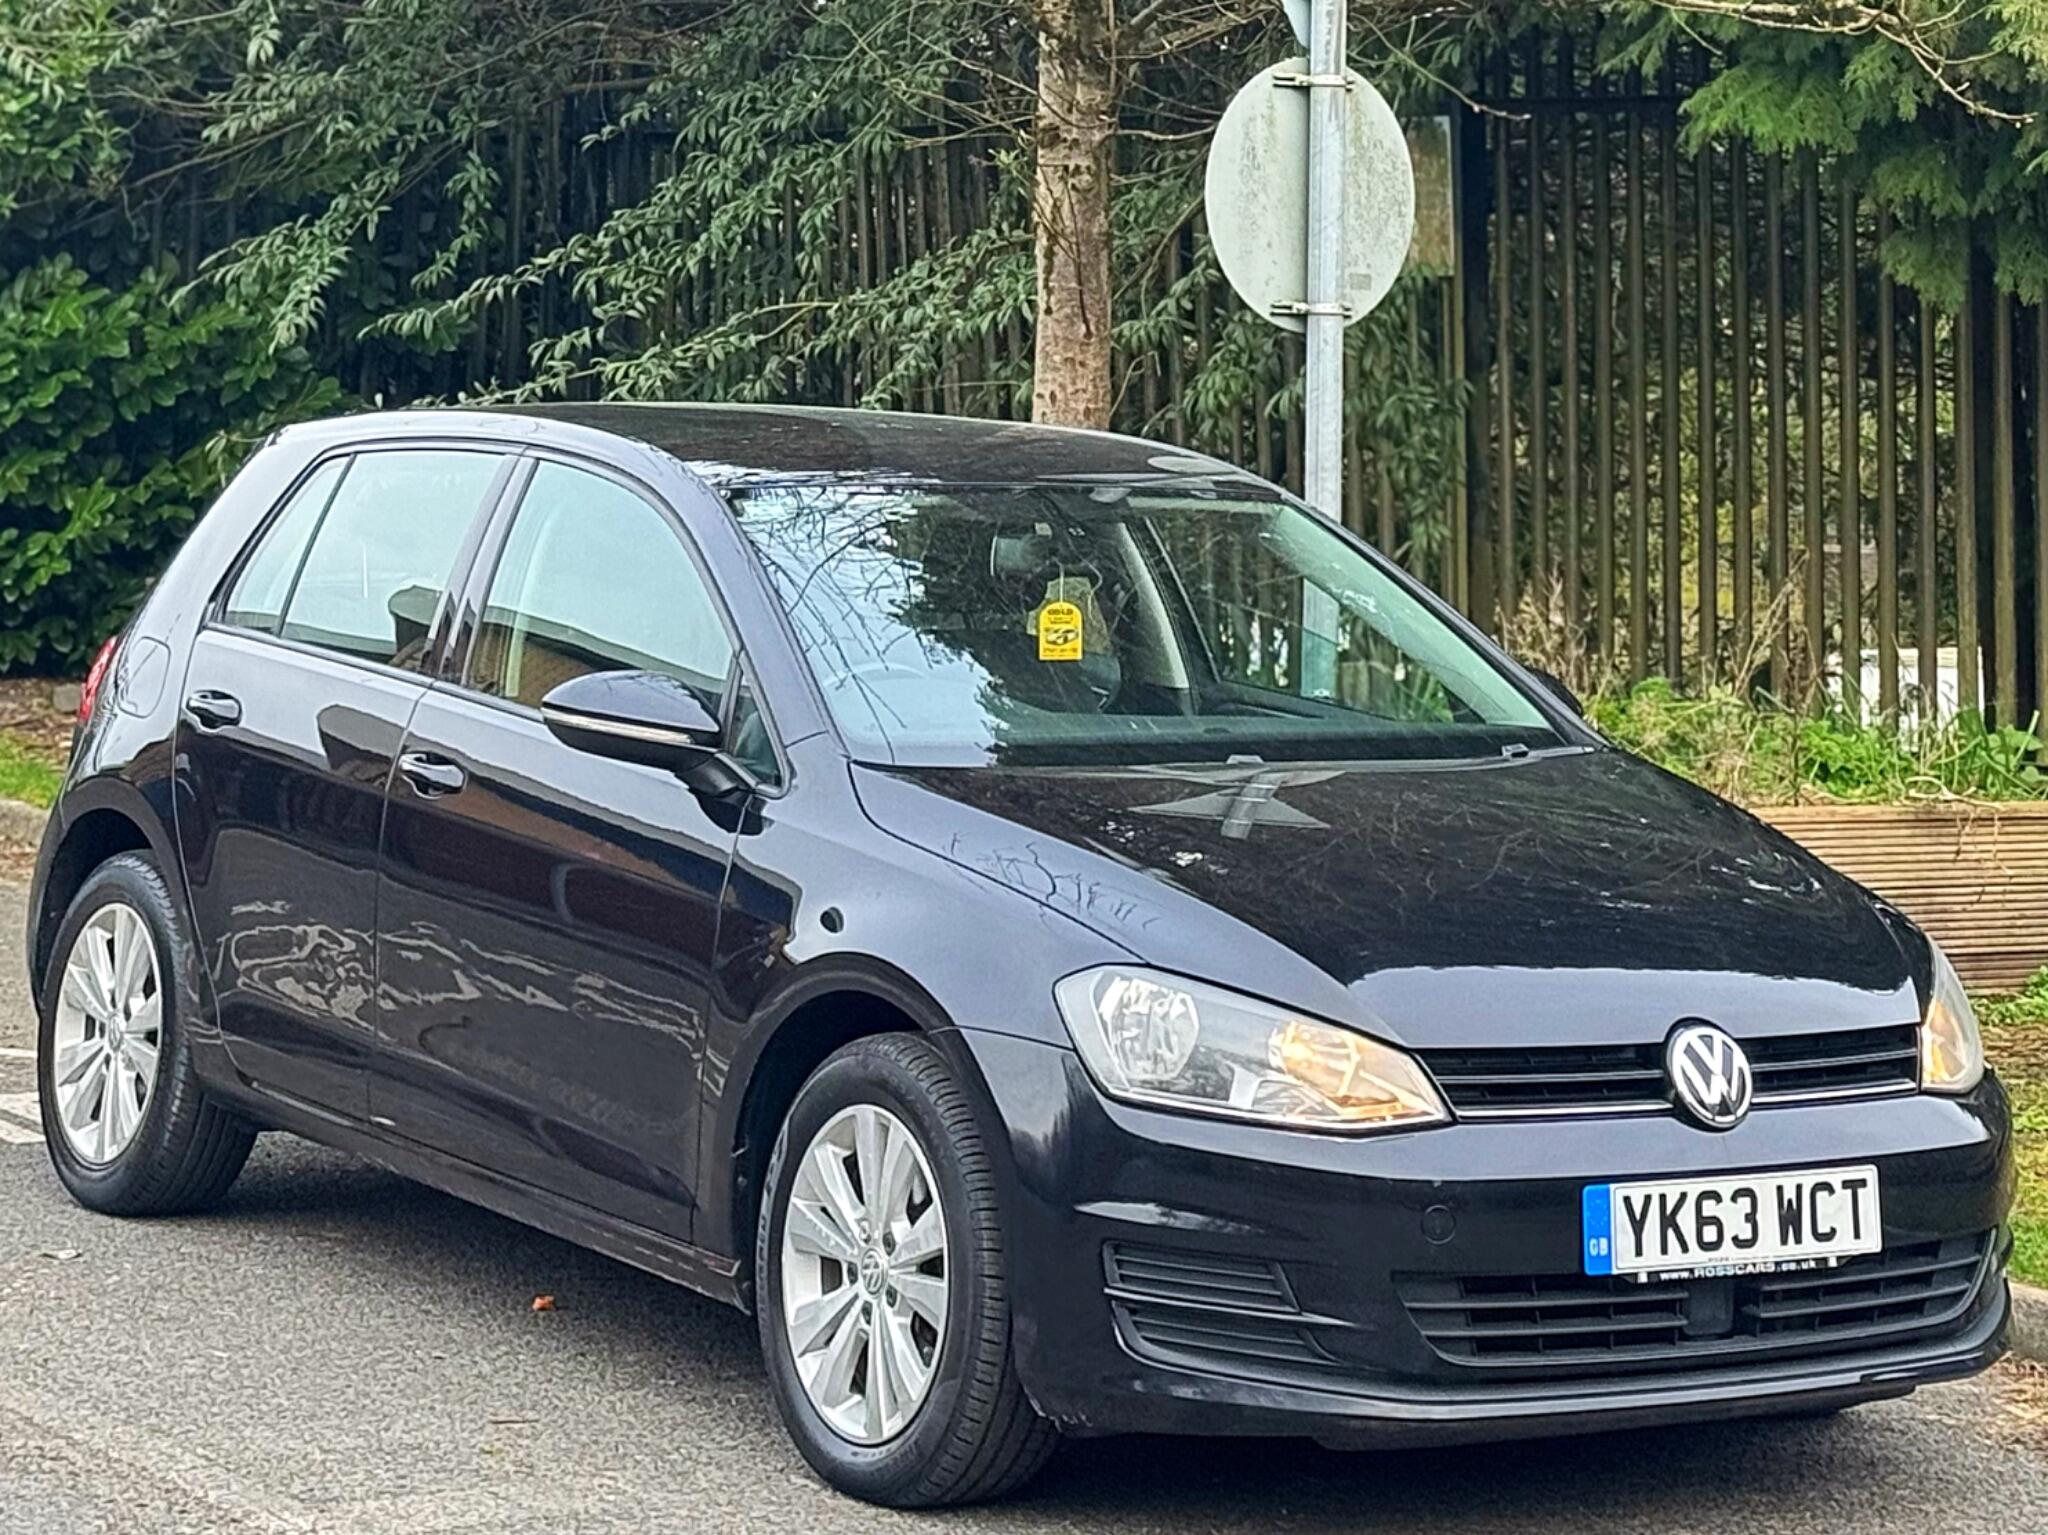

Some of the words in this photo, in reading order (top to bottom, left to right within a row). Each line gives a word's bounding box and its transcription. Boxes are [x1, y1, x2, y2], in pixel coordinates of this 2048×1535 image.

[1623, 1188, 1759, 1257] YK63
[1776, 1178, 1867, 1246] WCT
[1589, 1237, 1608, 1257] GB
